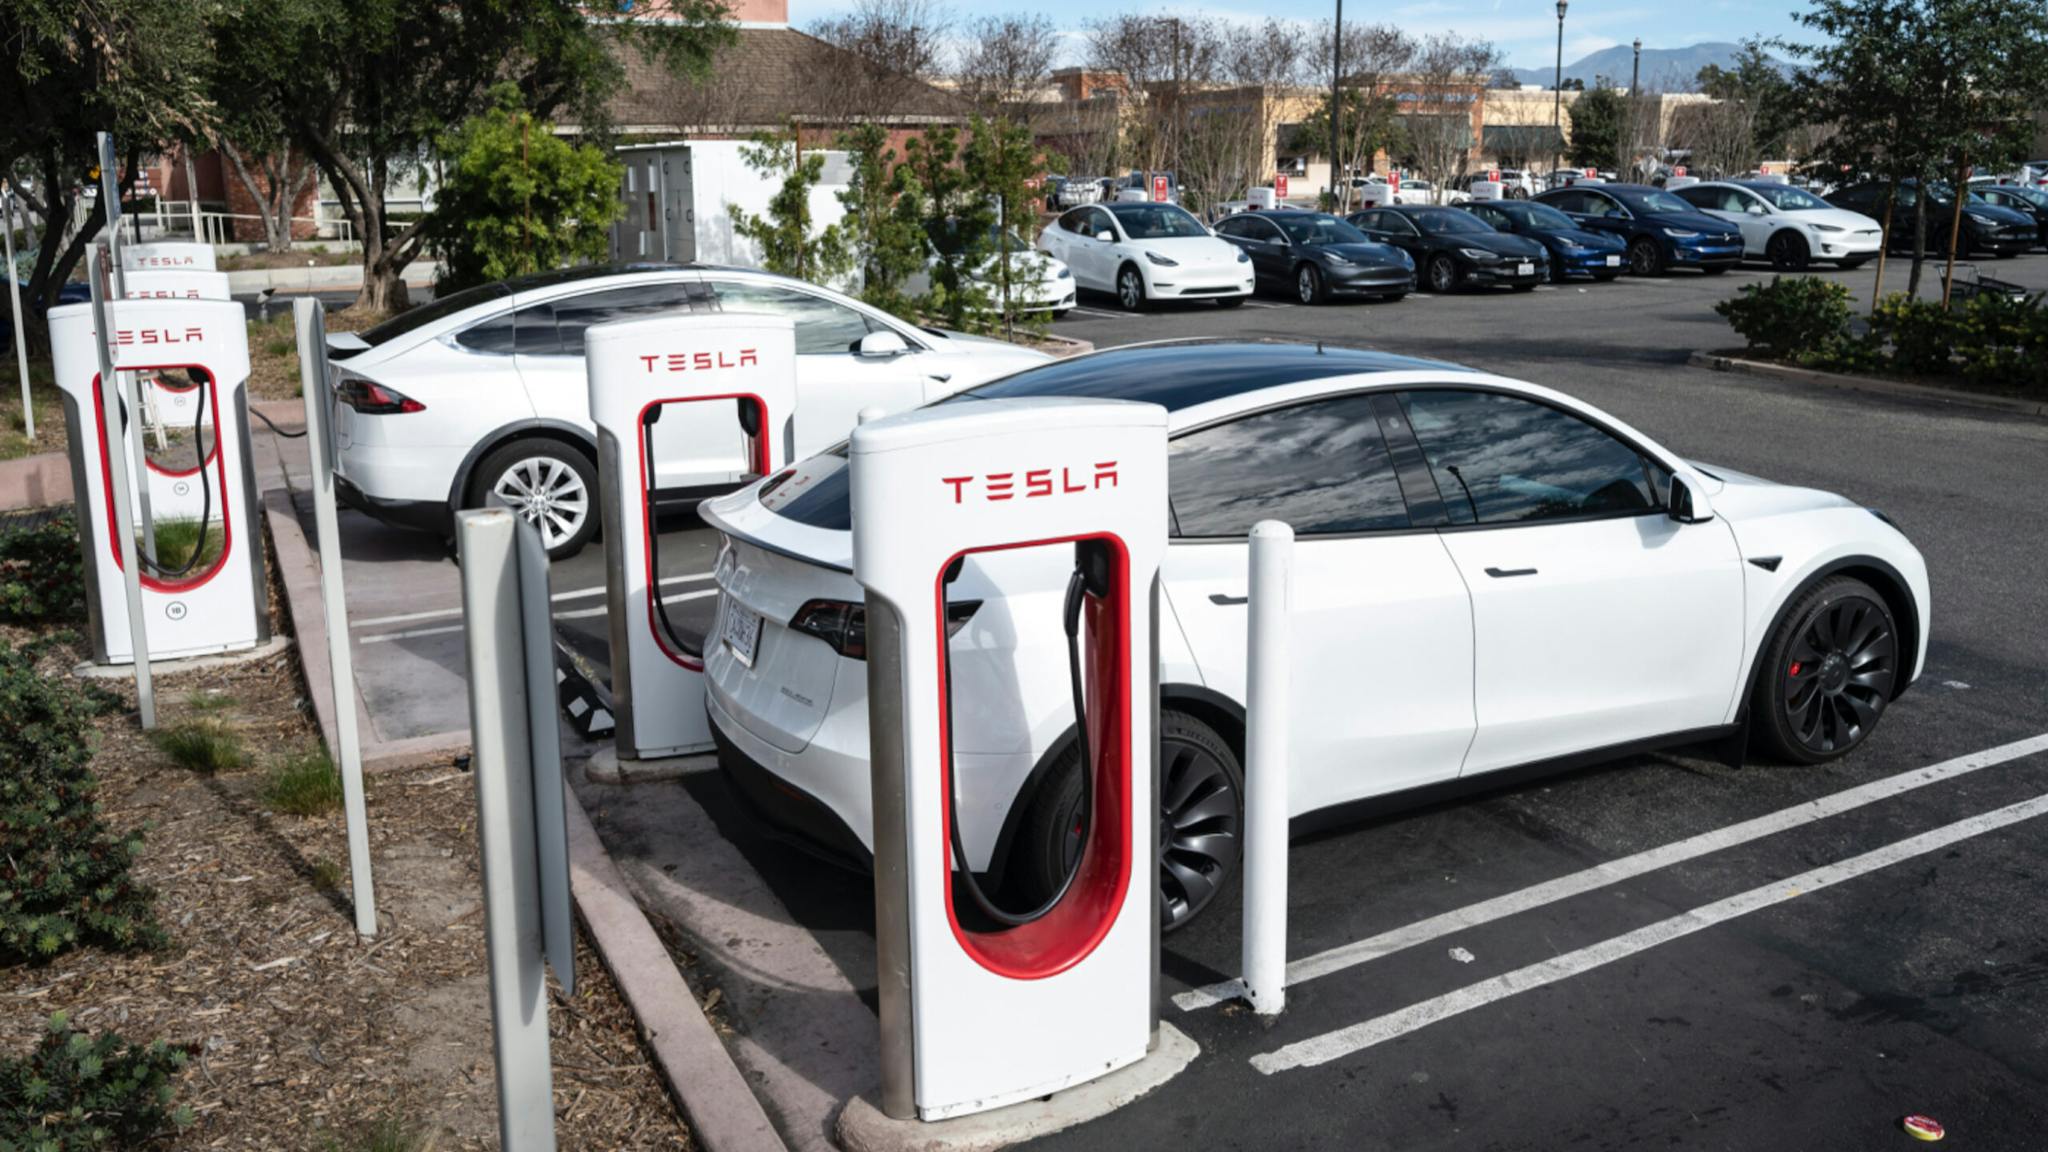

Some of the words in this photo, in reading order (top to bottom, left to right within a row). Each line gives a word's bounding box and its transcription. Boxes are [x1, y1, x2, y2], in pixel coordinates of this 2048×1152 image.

[137, 256, 194, 266] TESLA
[92, 327, 203, 345] ESLA
[640, 349, 757, 372] TESLA
[941, 460, 1118, 504] TESLA
